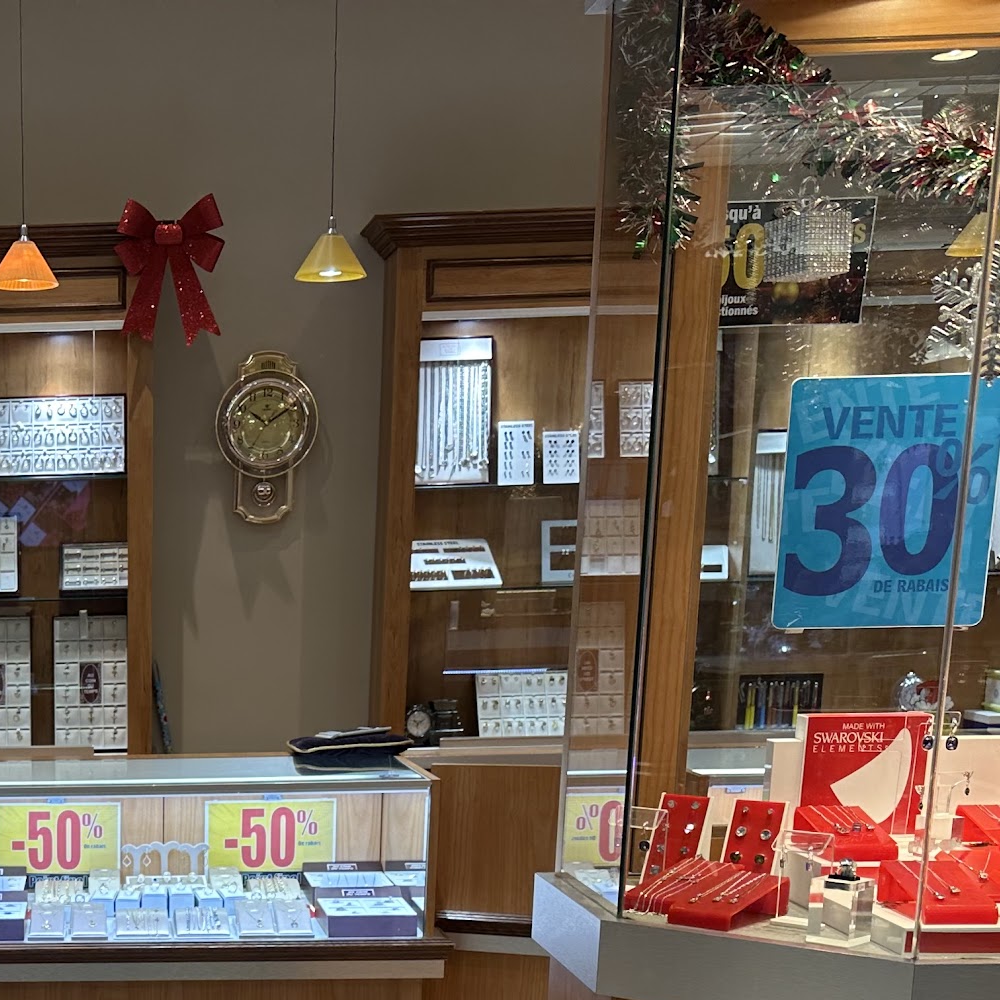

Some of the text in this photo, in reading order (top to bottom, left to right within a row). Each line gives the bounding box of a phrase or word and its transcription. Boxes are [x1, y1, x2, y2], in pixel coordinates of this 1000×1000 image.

[823, 404, 958, 440] VENTE
[874, 578, 949, 593] DE RABAIS
[814, 732, 884, 744] SWAROVSKI
[12, 810, 103, 870] -50%
[225, 807, 318, 868] -50%
